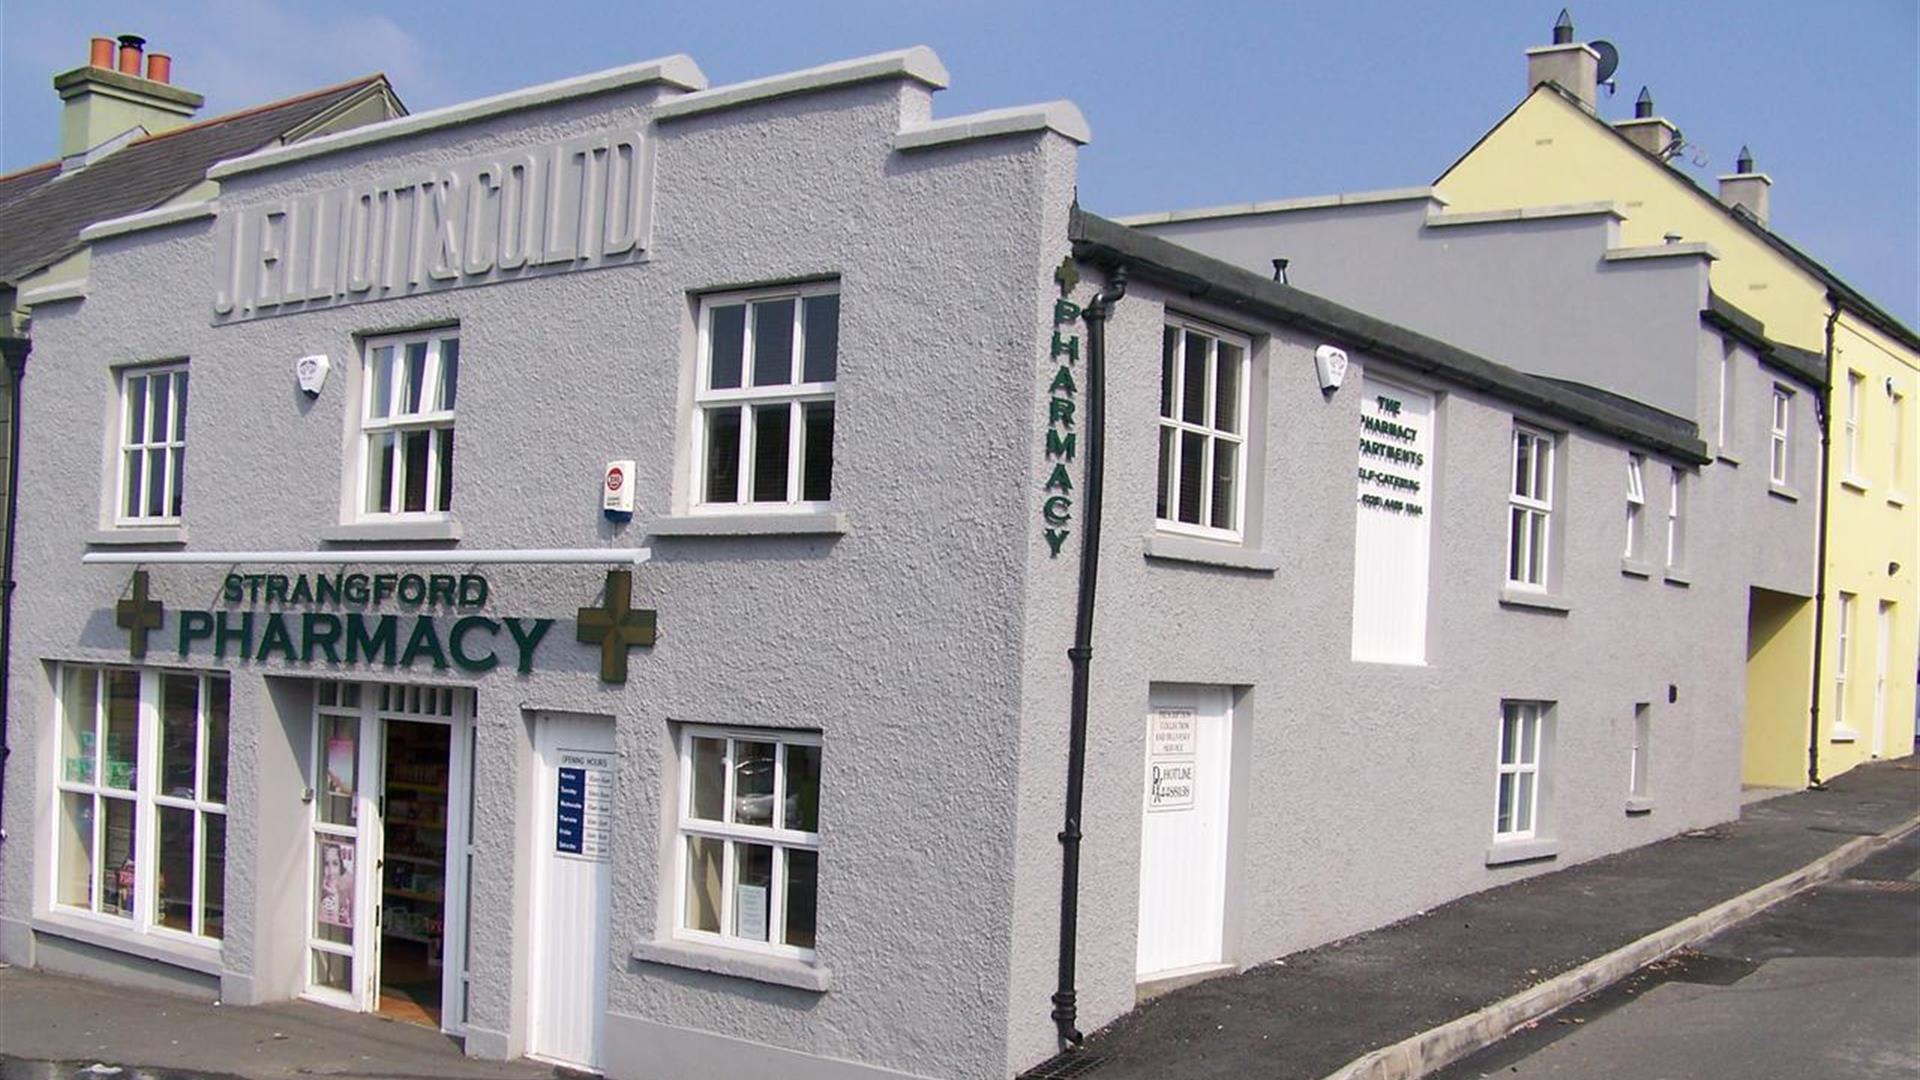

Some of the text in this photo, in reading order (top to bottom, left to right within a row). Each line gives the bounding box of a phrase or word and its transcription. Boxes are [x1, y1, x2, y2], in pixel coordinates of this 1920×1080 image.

[1043, 298, 1081, 558] PHARMACY
[1376, 396, 1402, 416] THE
[223, 573, 489, 609] STRANGFORD
[178, 610, 556, 674] PHARMACY
